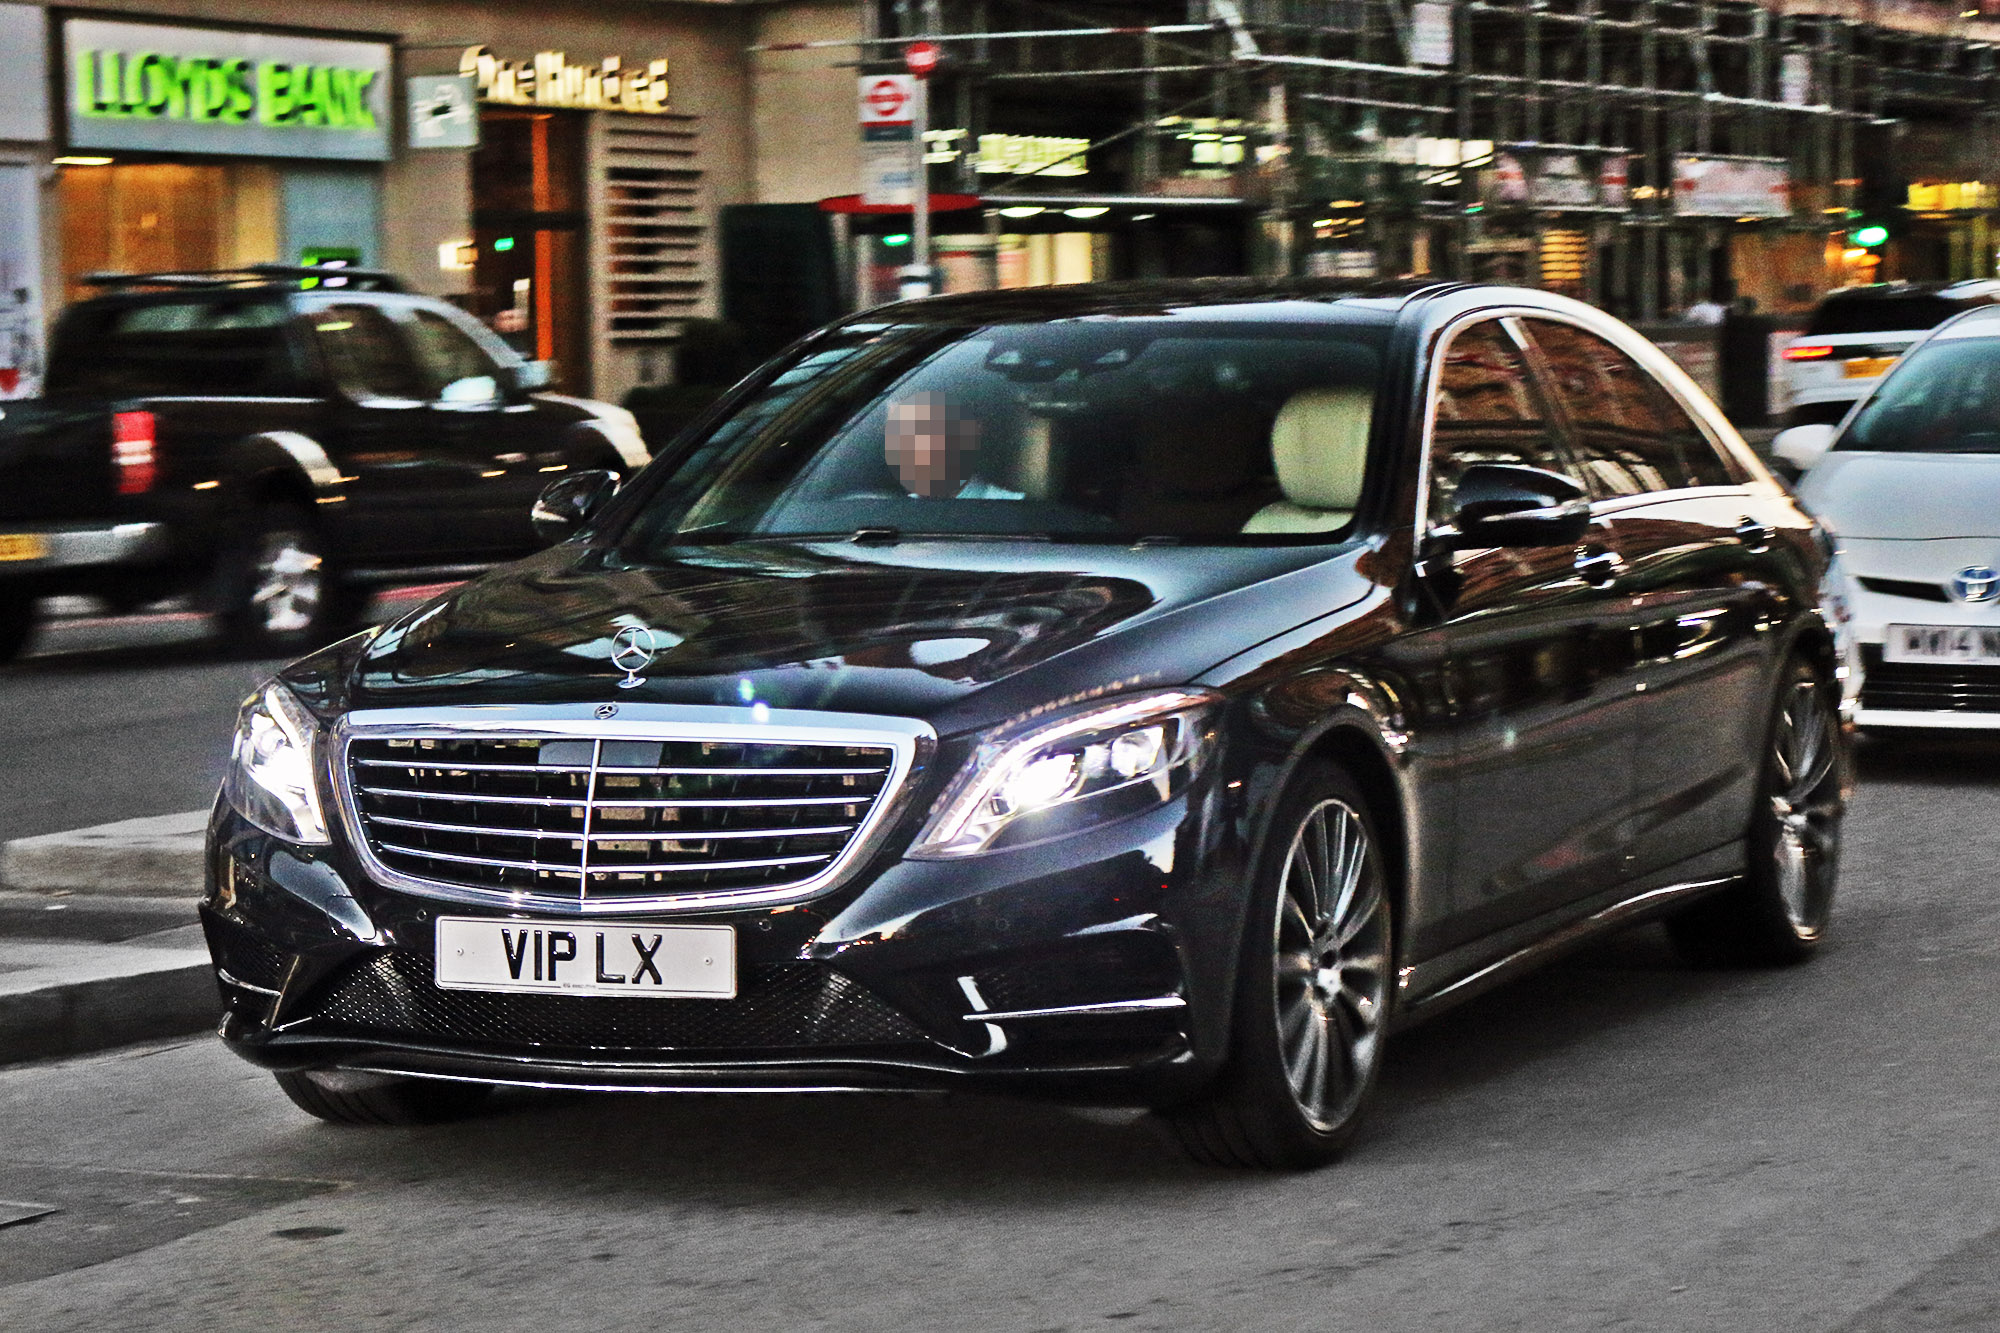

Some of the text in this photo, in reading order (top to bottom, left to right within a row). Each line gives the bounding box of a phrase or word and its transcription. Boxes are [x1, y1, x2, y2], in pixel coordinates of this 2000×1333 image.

[75, 50, 377, 130] LLOYDS BANK
[596, 932, 663, 985] LX
